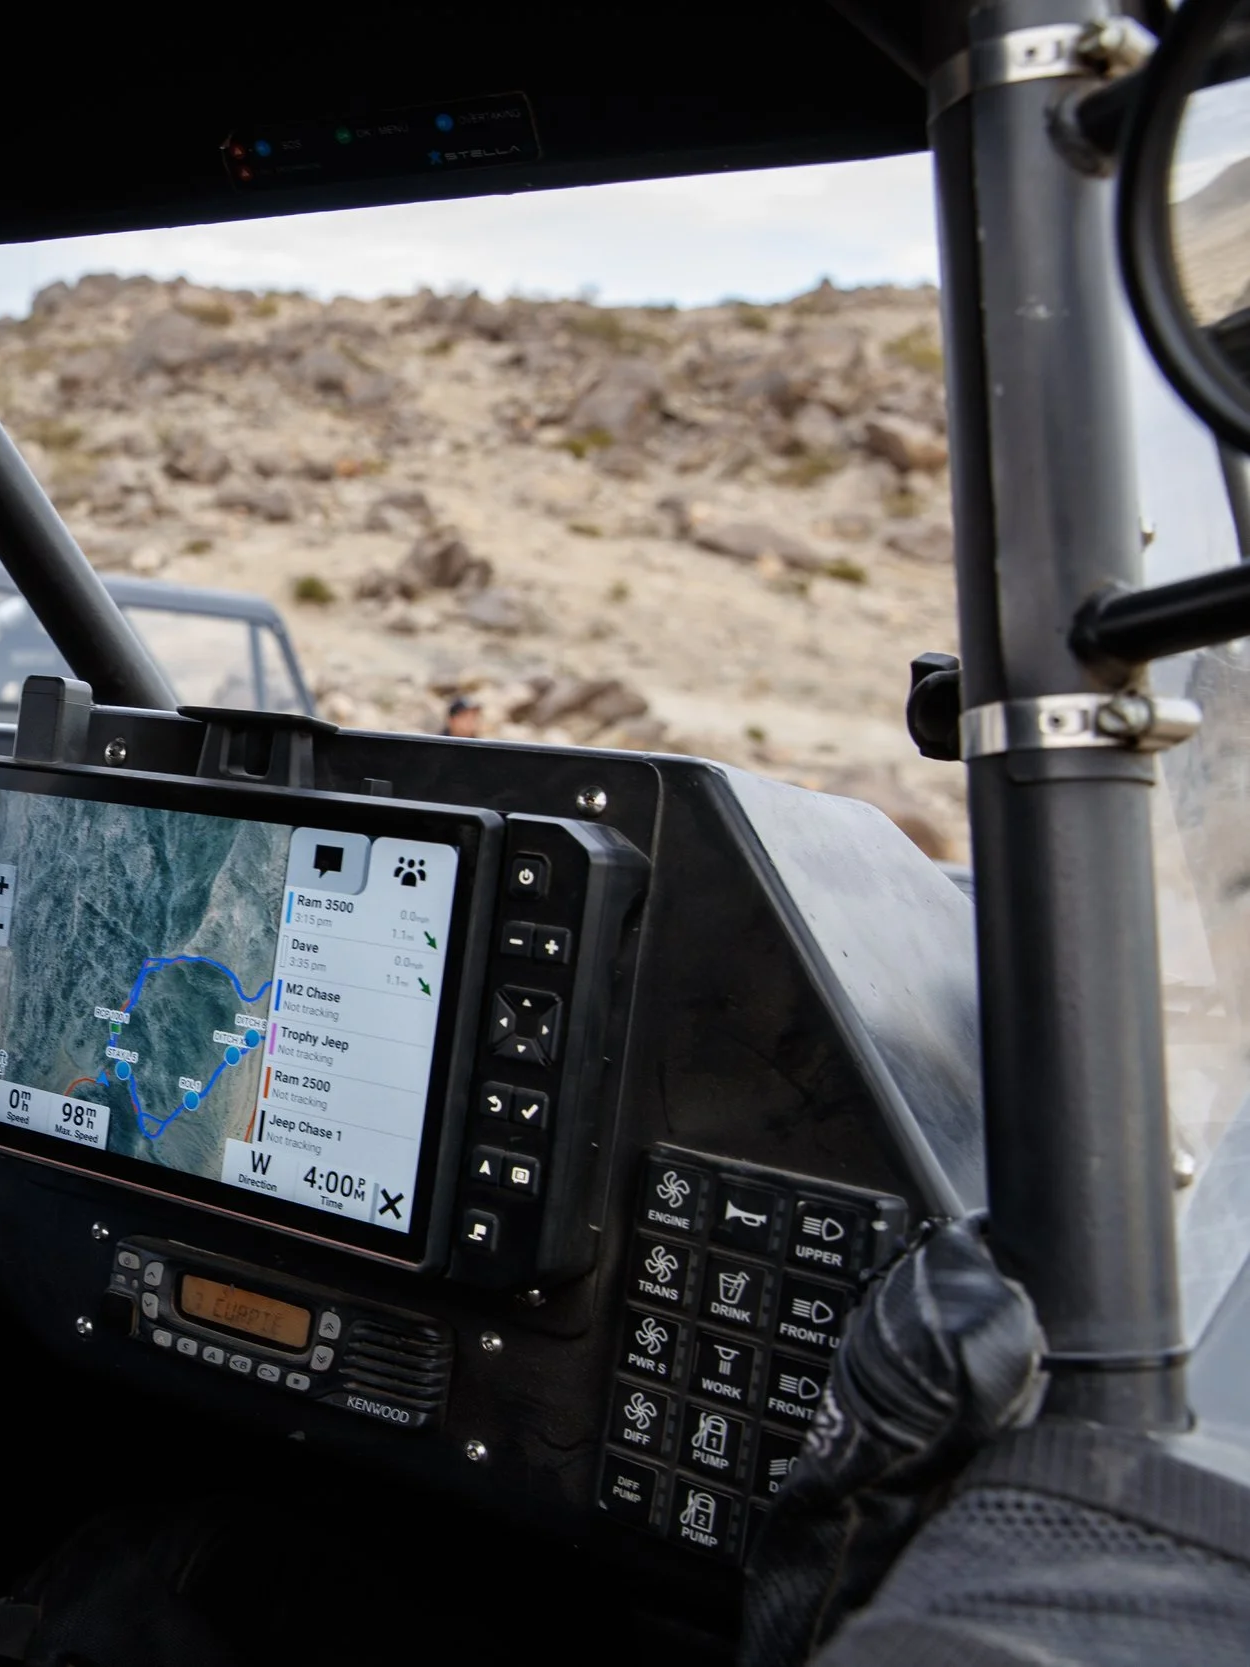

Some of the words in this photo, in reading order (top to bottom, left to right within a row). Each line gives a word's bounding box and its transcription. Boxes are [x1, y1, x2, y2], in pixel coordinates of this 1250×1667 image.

[443, 144, 521, 161] STELLA
[297, 894, 322, 910] Ram
[324, 897, 354, 914] 3500
[294, 912, 315, 926] 3:15
[316, 917, 333, 928] pm
[291, 938, 319, 954] Dave
[289, 956, 310, 970] 3:35
[310, 960, 327, 973] pm
[285, 982, 303, 997] M2
[306, 986, 341, 1003] Chase
[282, 1000, 300, 1013] Not
[301, 1004, 340, 1022] tracking
[281, 1026, 319, 1047] Trophy
[321, 1035, 349, 1053] Jeep
[277, 1044, 295, 1056] Not
[296, 1047, 334, 1066] tracking
[274, 1070, 299, 1086] Ram
[302, 1076, 331, 1093] 2500
[9, 1089, 20, 1109] 0
[271, 1088, 288, 1100] Not
[289, 1091, 328, 1111] tracking
[6, 1111, 30, 1125] Speed
[62, 1102, 84, 1126] 98
[54, 1124, 73, 1137] Max.
[74, 1129, 99, 1144] Speed
[269, 1114, 296, 1132] Jeep
[298, 1120, 333, 1140] Chase
[336, 1130, 342, 1142] 1
[265, 1131, 283, 1144] Not
[284, 1135, 322, 1155] tracking
[251, 1150, 272, 1175] W
[238, 1173, 277, 1192] Direction
[303, 1166, 354, 1198] 4:00
[320, 1195, 344, 1210] Time
[648, 1210, 690, 1230] ENGINE
[795, 1245, 842, 1267] UPPER
[638, 1279, 678, 1300] TRANS
[710, 1302, 750, 1323] DRINK
[779, 1322, 826, 1345] FRONT
[182, 1342, 190, 1351] S
[207, 1351, 216, 1361] A
[627, 1353, 655, 1371] PWR
[657, 1361, 667, 1375] S
[701, 1377, 742, 1400] WORK
[346, 1394, 410, 1424] KENWOOD
[768, 1397, 814, 1420] FRONT
[623, 1428, 650, 1446] DIFF
[692, 1450, 730, 1470] PUMP
[617, 1475, 640, 1490] DIFF
[612, 1485, 642, 1503] PUMP
[681, 1526, 718, 1548] PUMP
